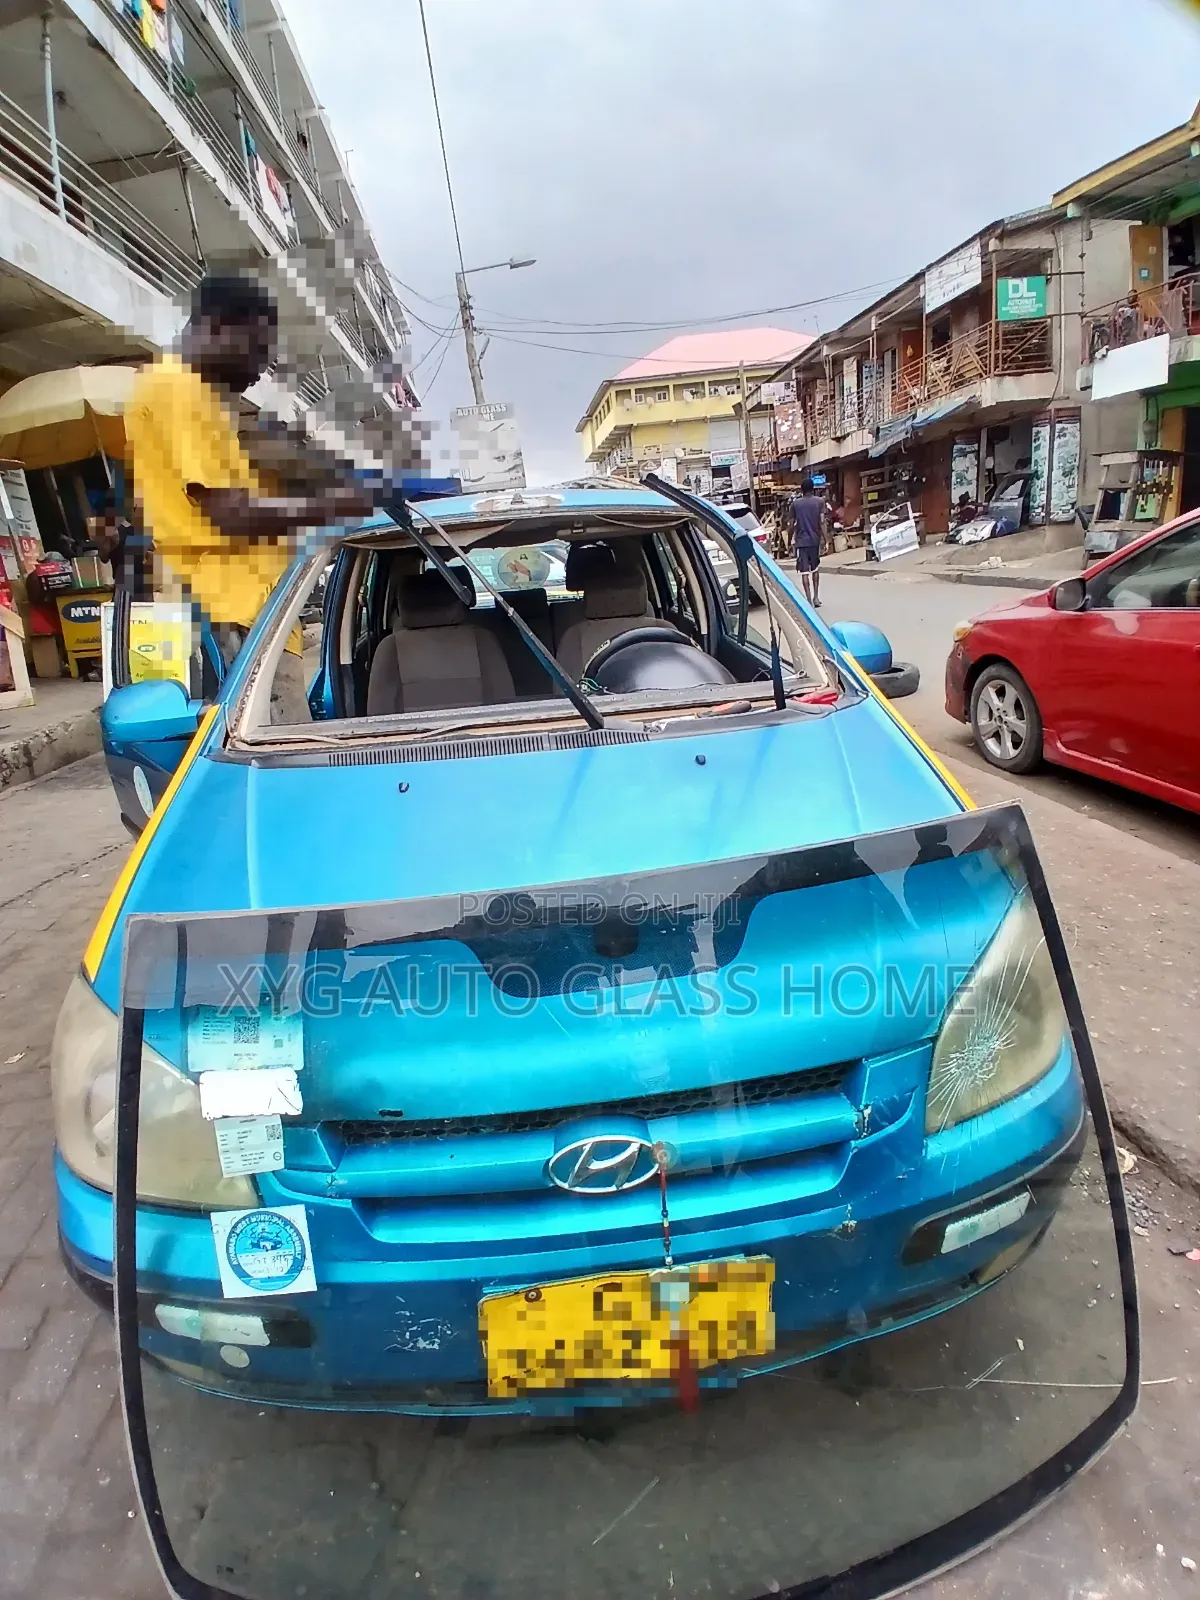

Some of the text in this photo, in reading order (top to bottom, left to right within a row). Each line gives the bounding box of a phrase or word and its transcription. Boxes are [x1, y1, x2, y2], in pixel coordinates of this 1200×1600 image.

[1008, 278, 1037, 298] DL
[457, 403, 507, 416] AUTO GLASS
[70, 606, 100, 618] MTN
